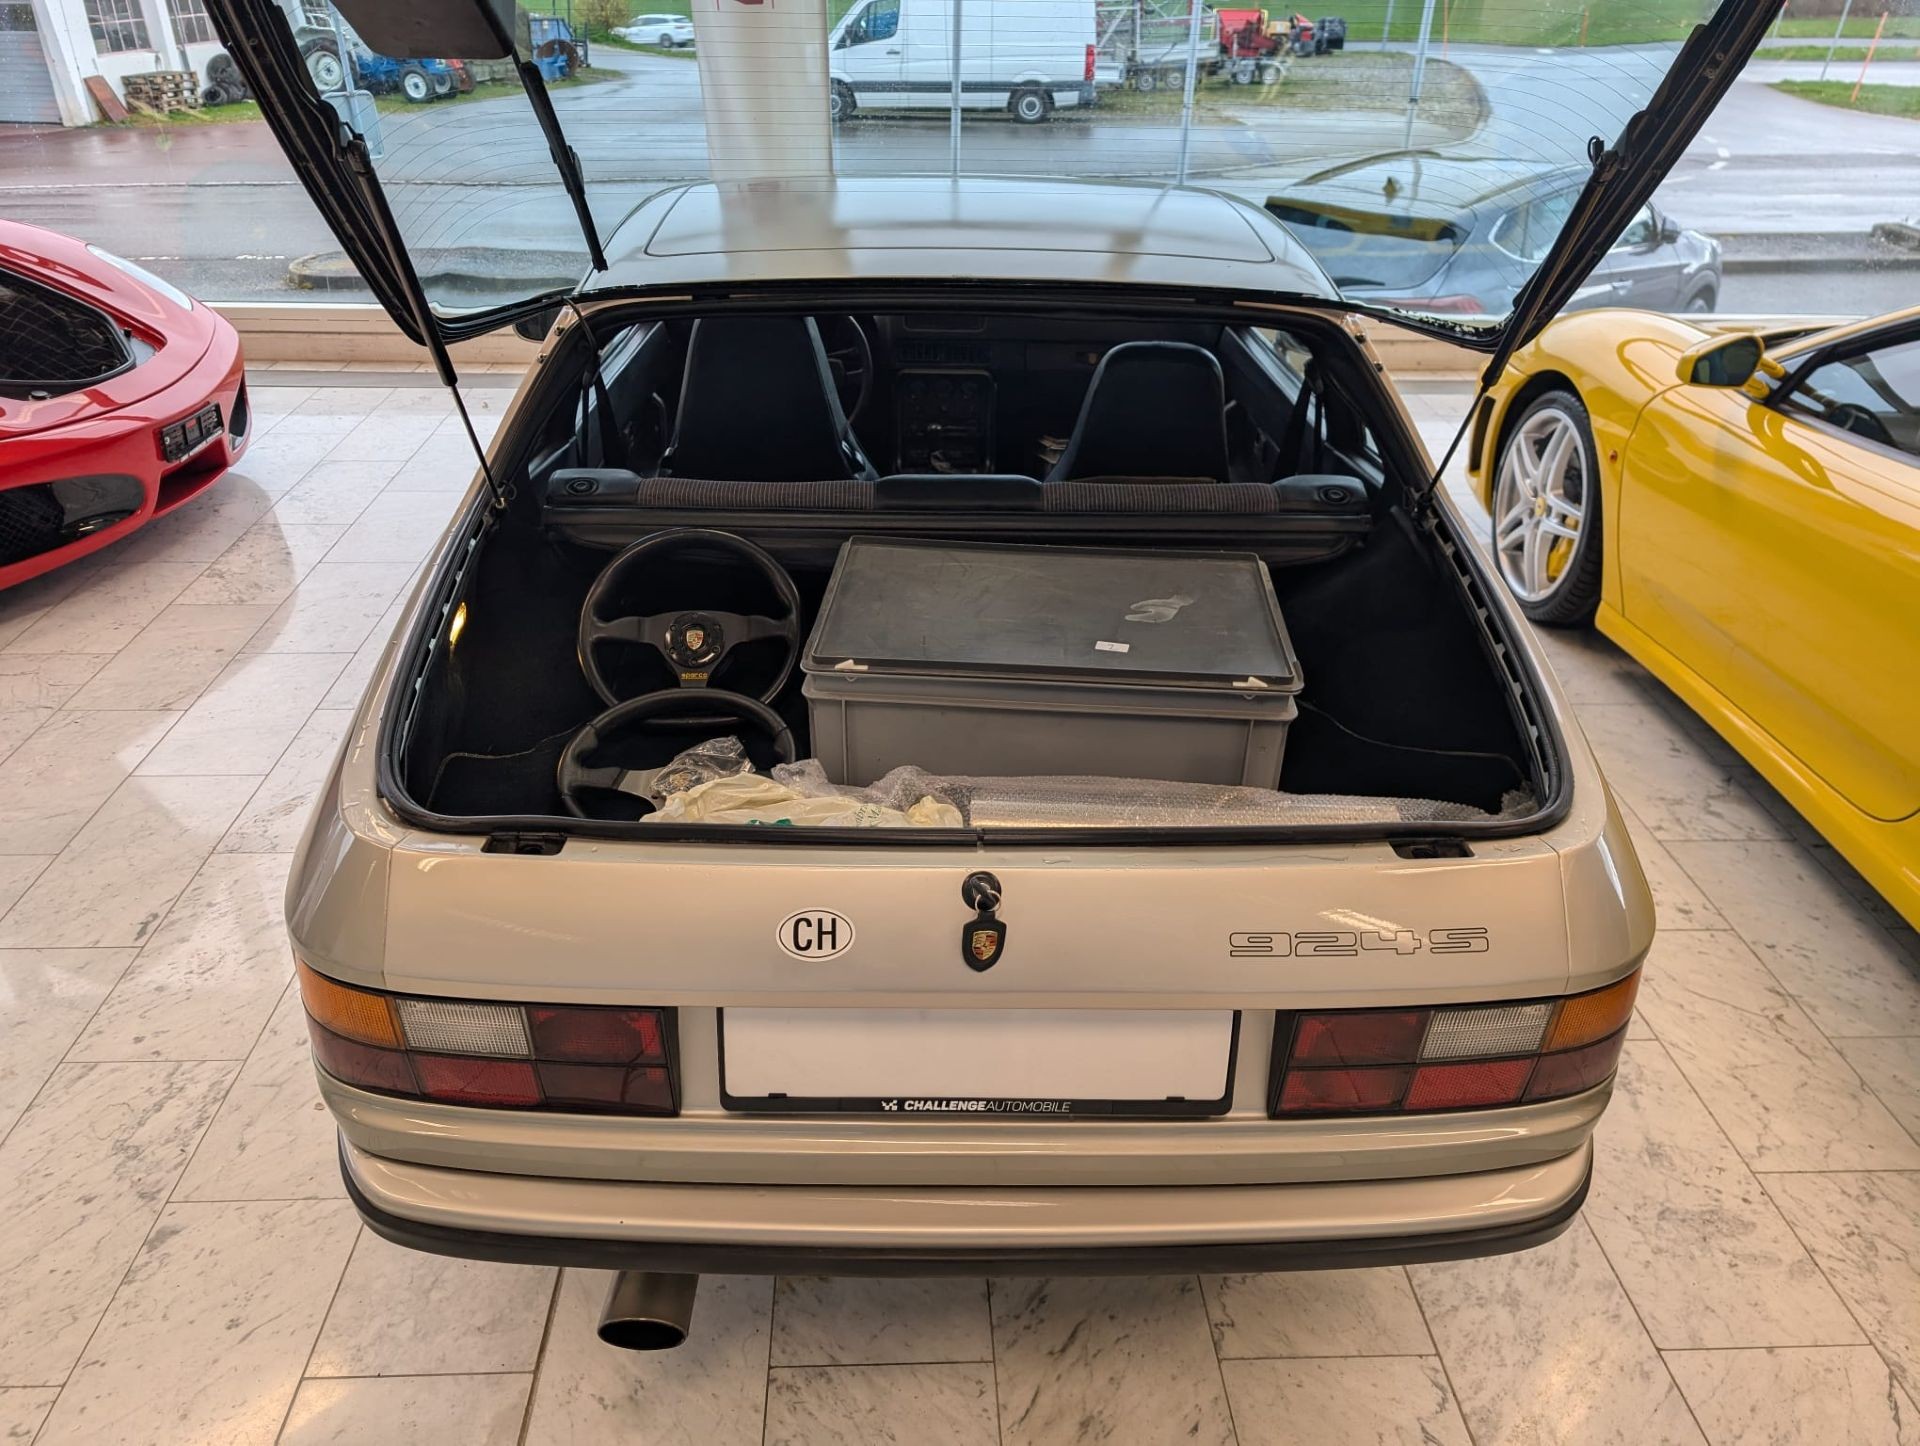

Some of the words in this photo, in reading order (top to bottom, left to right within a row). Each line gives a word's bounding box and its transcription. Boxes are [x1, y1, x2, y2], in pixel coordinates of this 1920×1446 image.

[681, 672, 708, 680] sparco
[792, 917, 837, 952] CH
[1229, 927, 1490, 957] 924S
